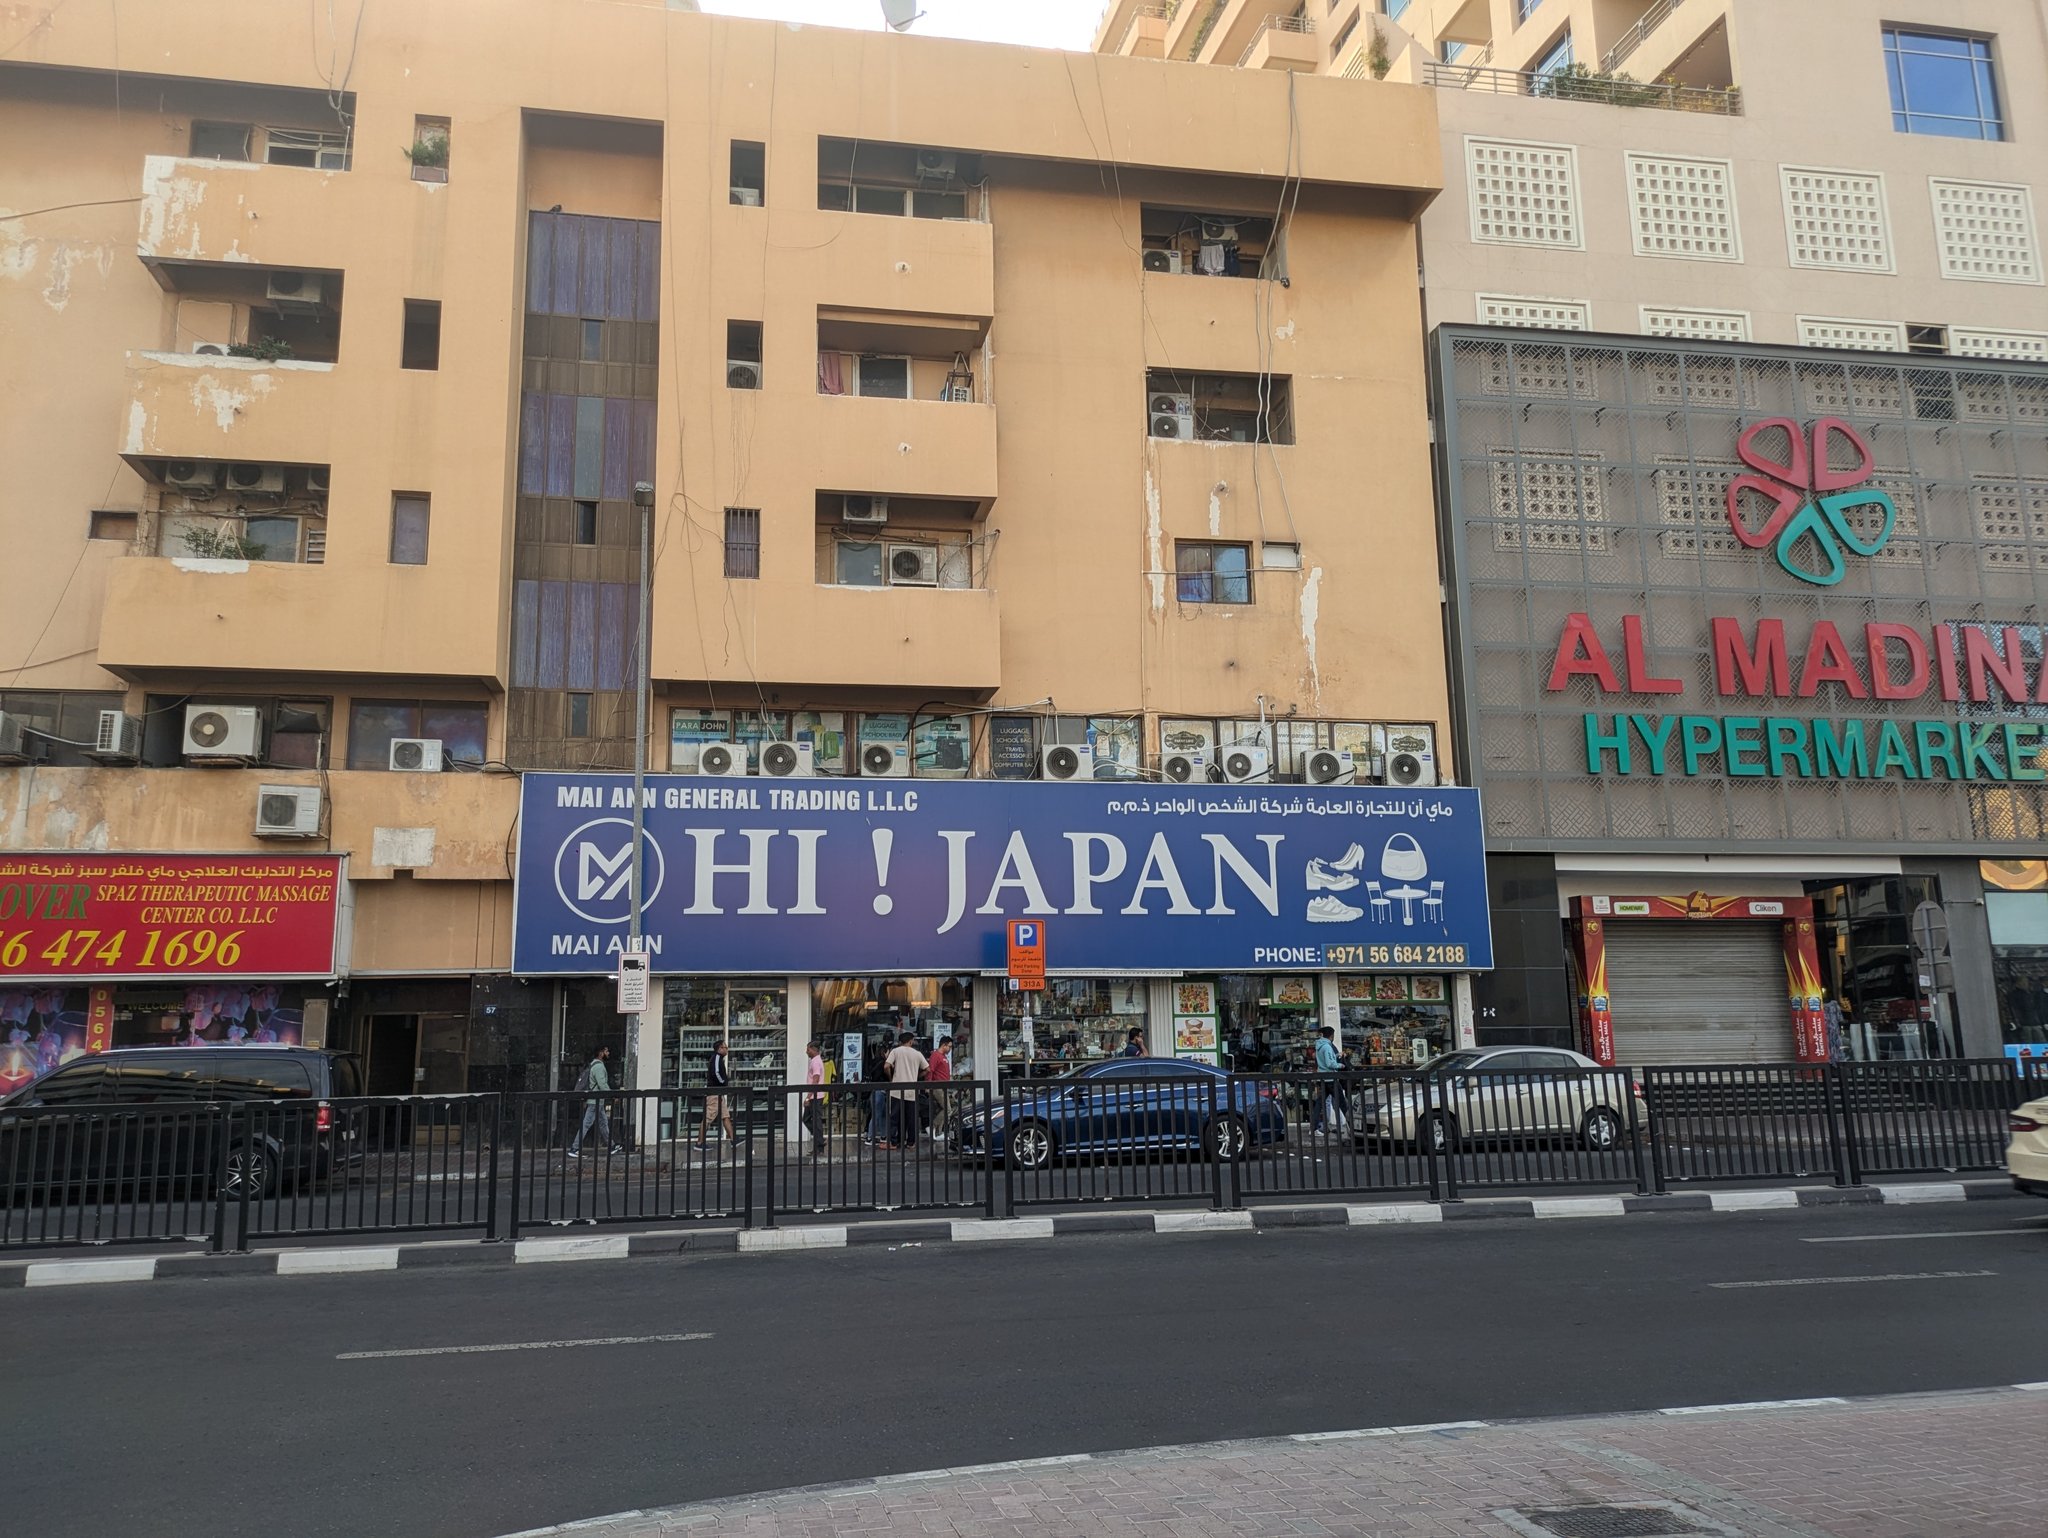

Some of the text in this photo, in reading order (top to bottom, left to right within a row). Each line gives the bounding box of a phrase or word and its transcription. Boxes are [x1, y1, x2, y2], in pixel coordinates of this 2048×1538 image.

[1546, 612, 2048, 703] AL MADIN
[676, 722, 726, 730] PARA JOHN
[1582, 713, 2048, 782] HYPERMARKE
[557, 786, 918, 812] MAI ANN GENERAL TRADING L.L.C
[1198, 796, 1257, 816] الشخص
[1260, 797, 1303, 816] شركة
[1306, 798, 1353, 815] العامة
[1355, 800, 1406, 817] للتجارة
[1427, 801, 1453, 822] ماي
[30, 863, 74, 878] شركة
[78, 864, 107, 878] سبز
[147, 865, 175, 881] ماي
[178, 866, 238, 881] العلاجي
[241, 866, 295, 878] التدليك
[298, 865, 333, 879] مركز
[683, 828, 1285, 935] HI ! JAPAN
[141, 885, 254, 902] THERAPEUTIC
[256, 885, 331, 902] MASSAGE
[141, 907, 278, 924] CENTER CO. L.L.C
[1018, 924, 1034, 946] P
[0, 929, 246, 967] 6 474 1696
[552, 934, 599, 955] MAI
[1254, 946, 1464, 964] PHONE: +971 56 684 2188
[1023, 980, 1041, 988] 313A
[128, 1001, 185, 1010] WELCOME
[485, 1006, 496, 1014] 57
